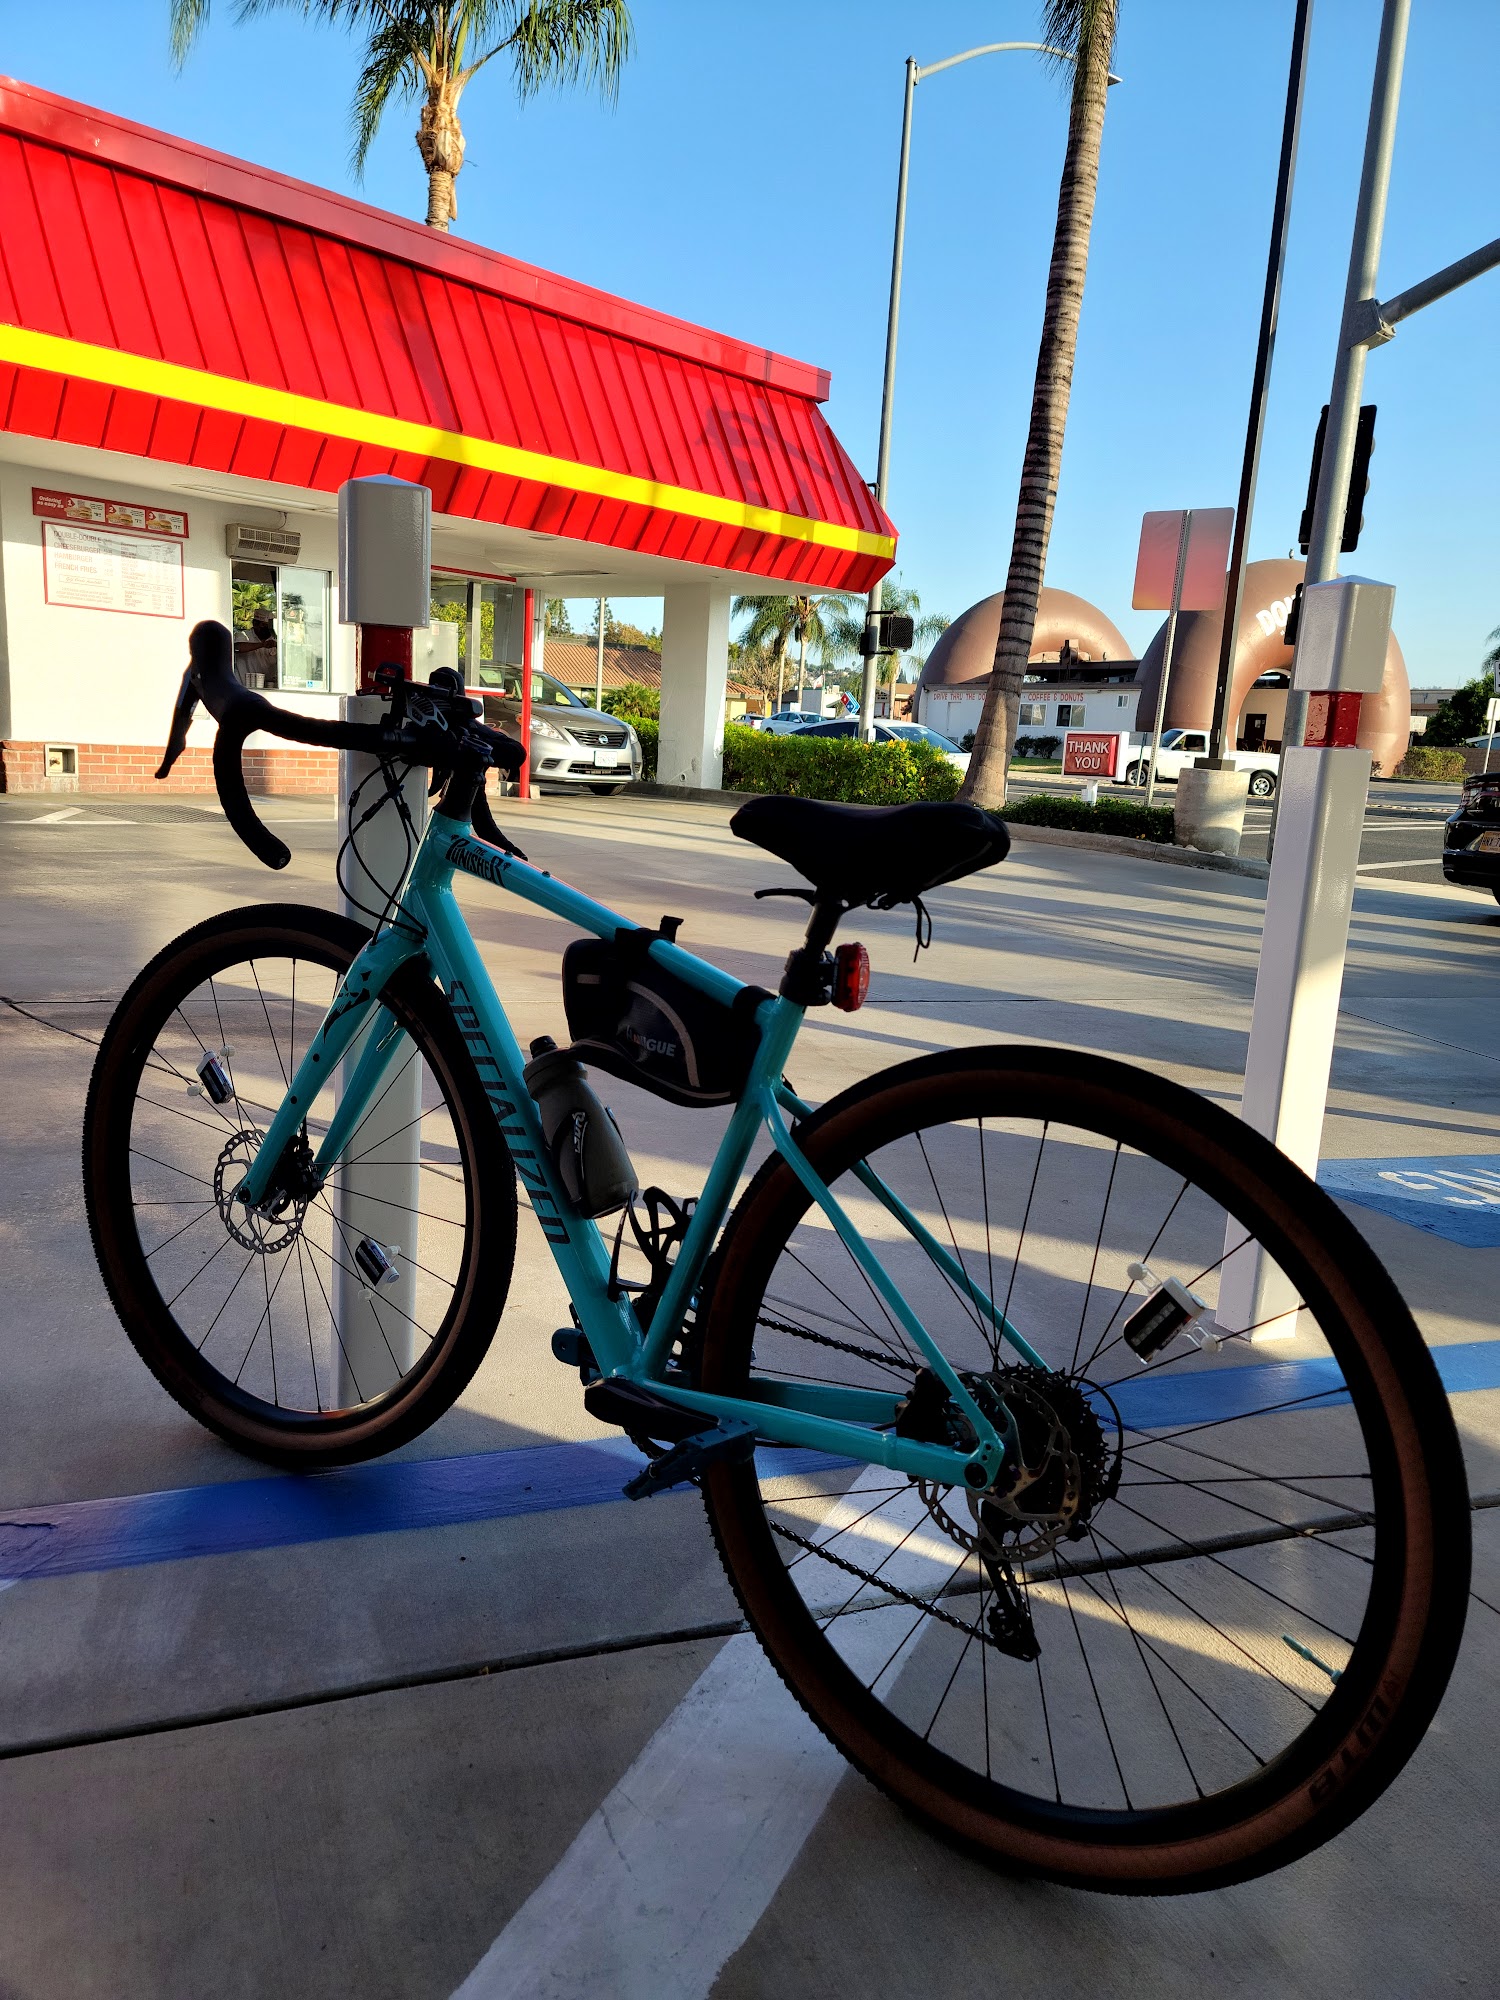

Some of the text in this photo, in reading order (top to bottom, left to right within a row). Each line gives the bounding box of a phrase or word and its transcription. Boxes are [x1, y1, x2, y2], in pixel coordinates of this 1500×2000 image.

[53, 530, 102, 544] DOUBLE-DOUBLE
[53, 542, 101, 555] CHEESEBURGER
[54, 552, 93, 563] HAMBURGER
[54, 562, 79, 571] FRENCH
[80, 565, 97, 574] FRIES
[933, 692, 948, 701] DRIVE
[950, 692, 964, 701] THRU
[966, 692, 976, 701] THE
[1028, 692, 1051, 701] COFFEE
[1060, 692, 1084, 702] DONUTS
[1067, 740, 1110, 754] THANK
[1074, 756, 1101, 770] YOU
[450, 979, 571, 1245] SPECIALIZED
